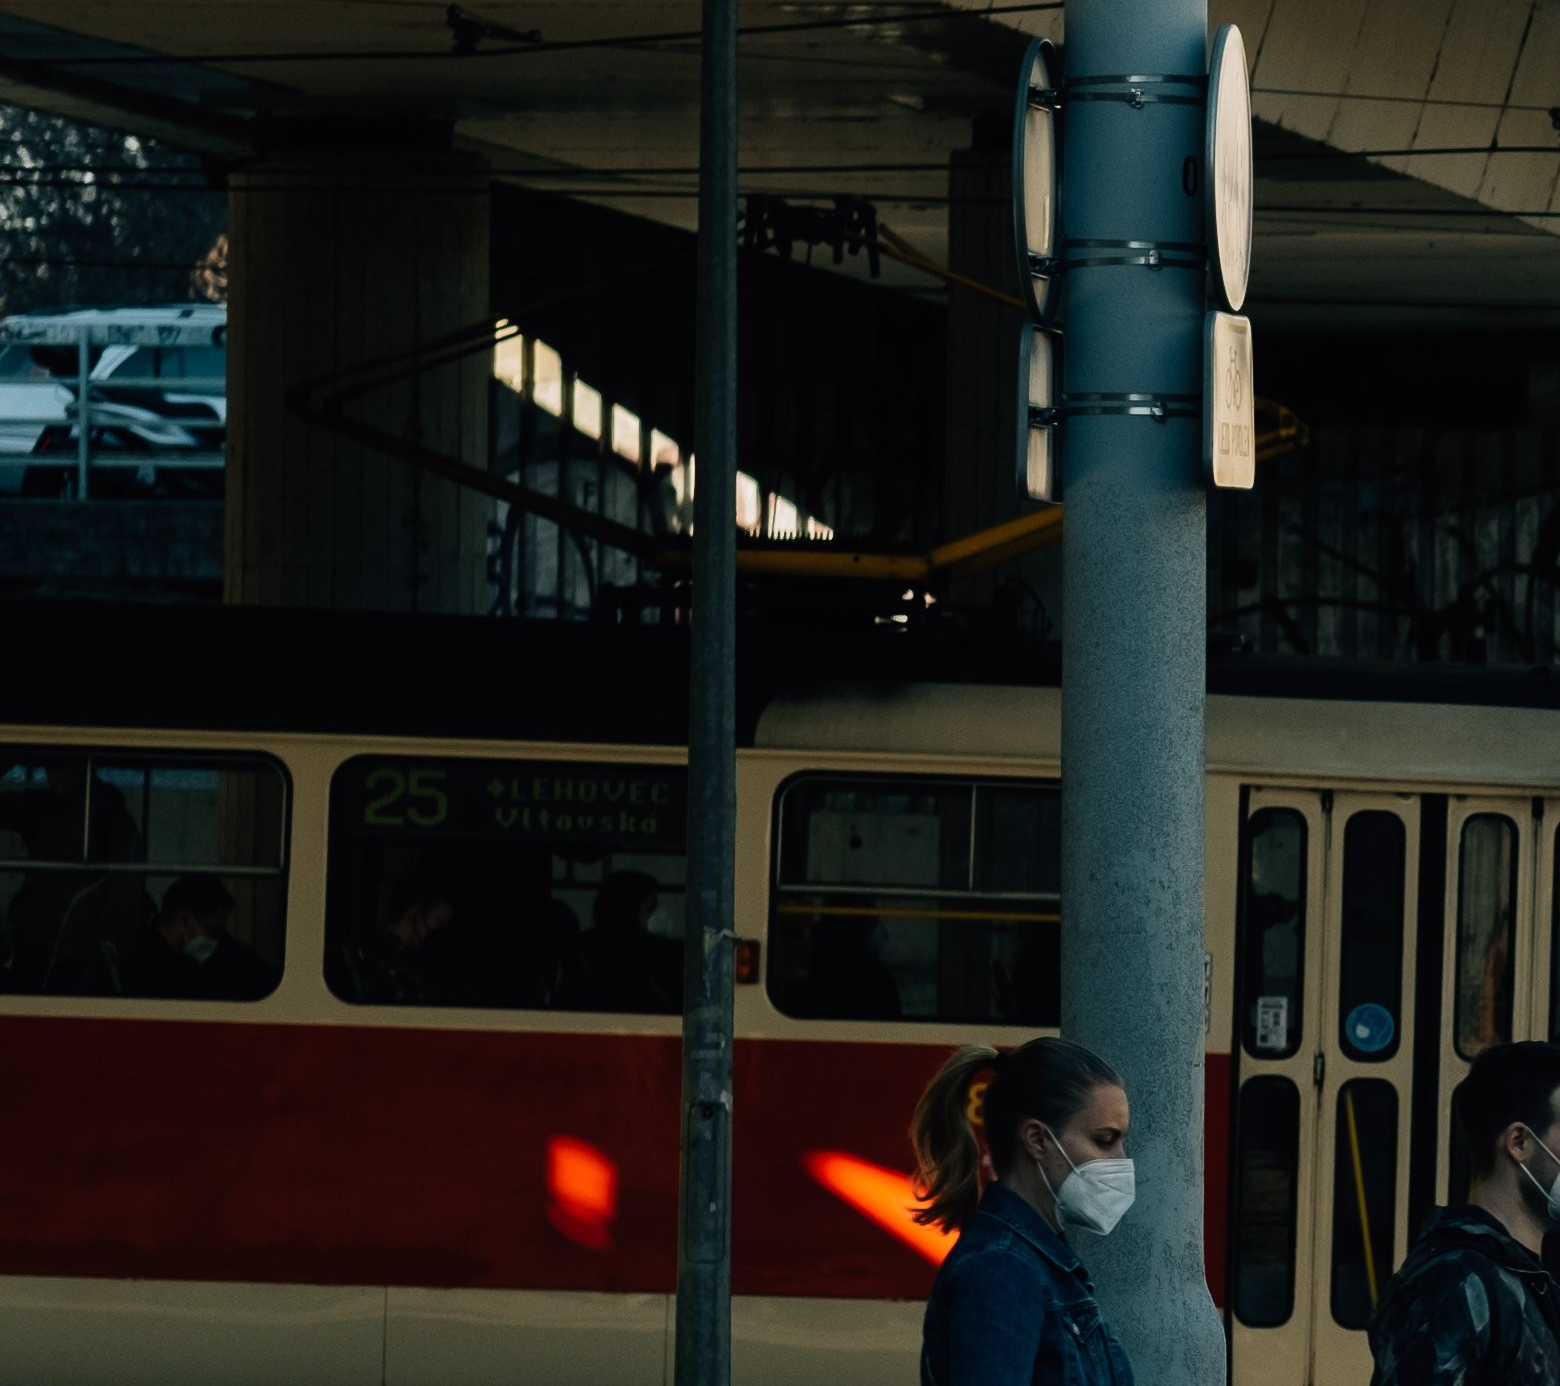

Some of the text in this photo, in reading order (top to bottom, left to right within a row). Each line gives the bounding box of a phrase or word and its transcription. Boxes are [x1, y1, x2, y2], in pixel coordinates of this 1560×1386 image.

[361, 765, 672, 829] 25 LEHOVEC
[494, 804, 659, 836] Vltavská
